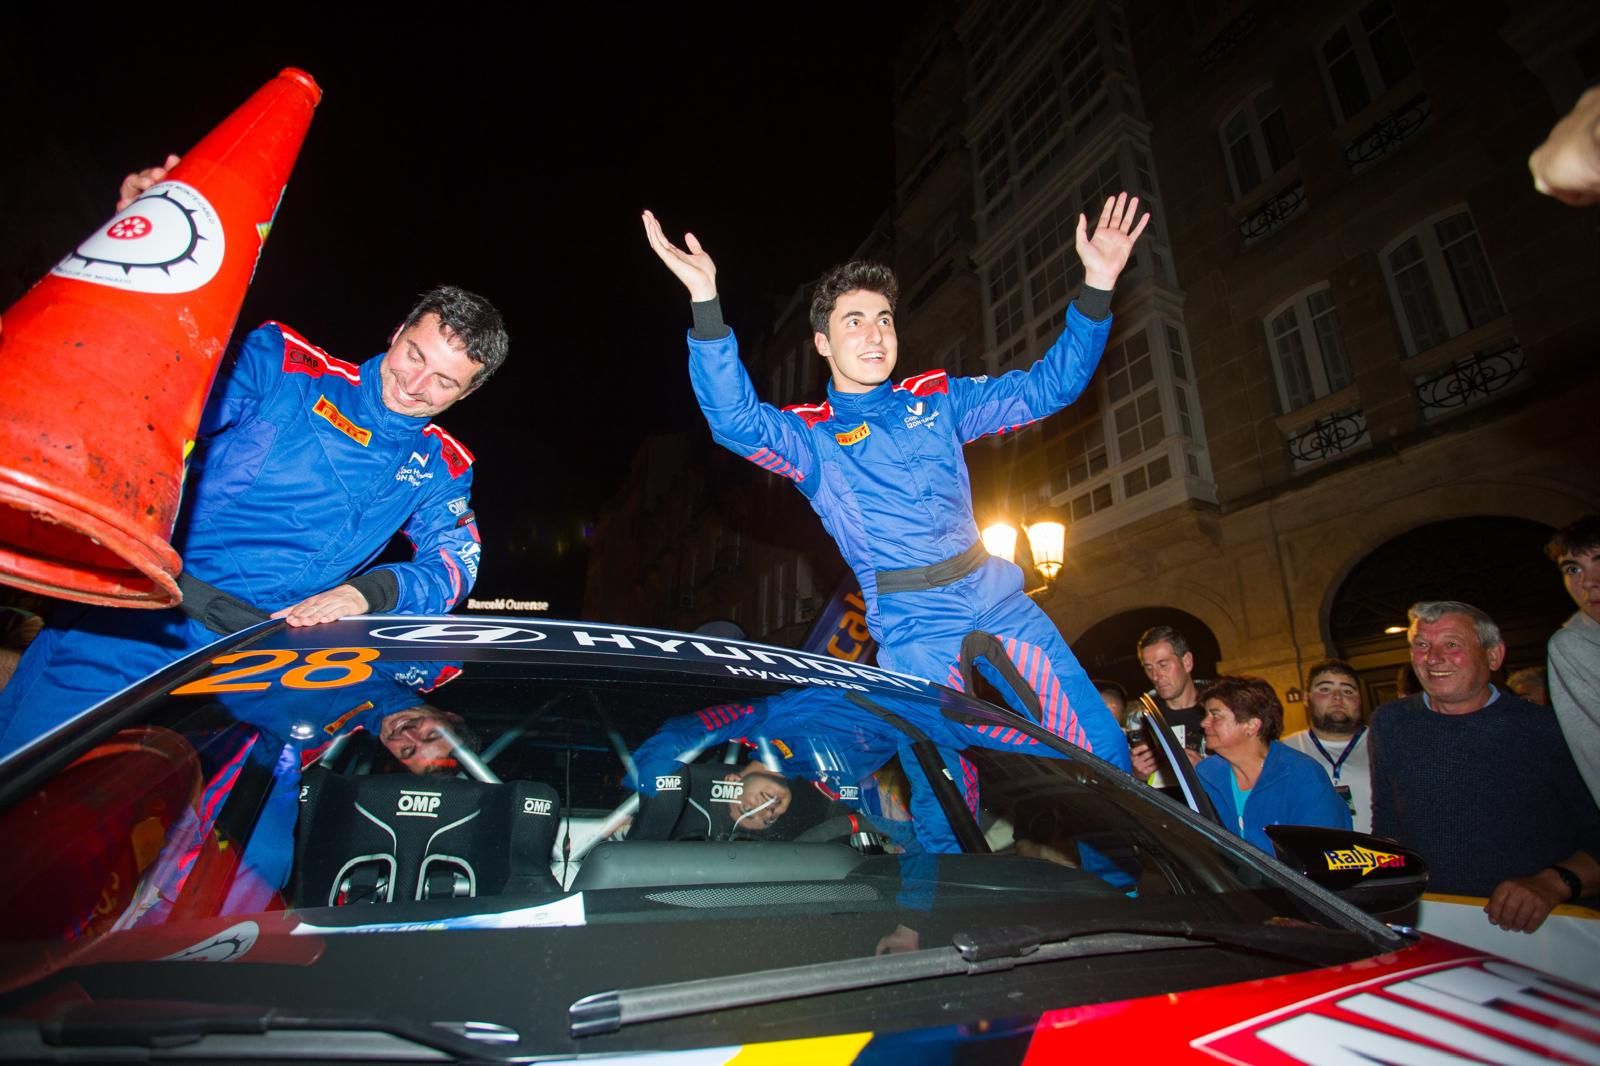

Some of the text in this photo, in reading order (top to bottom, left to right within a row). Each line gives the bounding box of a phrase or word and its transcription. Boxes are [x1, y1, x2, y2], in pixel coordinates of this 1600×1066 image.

[505, 599, 549, 610] Ourense
[169, 647, 381, 695] 28
[573, 631, 923, 692] HYUNDAI
[724, 665, 870, 692] Hyupersa
[656, 777, 681, 790] OMP
[711, 782, 743, 802] OMP
[840, 787, 858, 799] OMP
[397, 793, 441, 814] OMP
[524, 799, 552, 813] OMP
